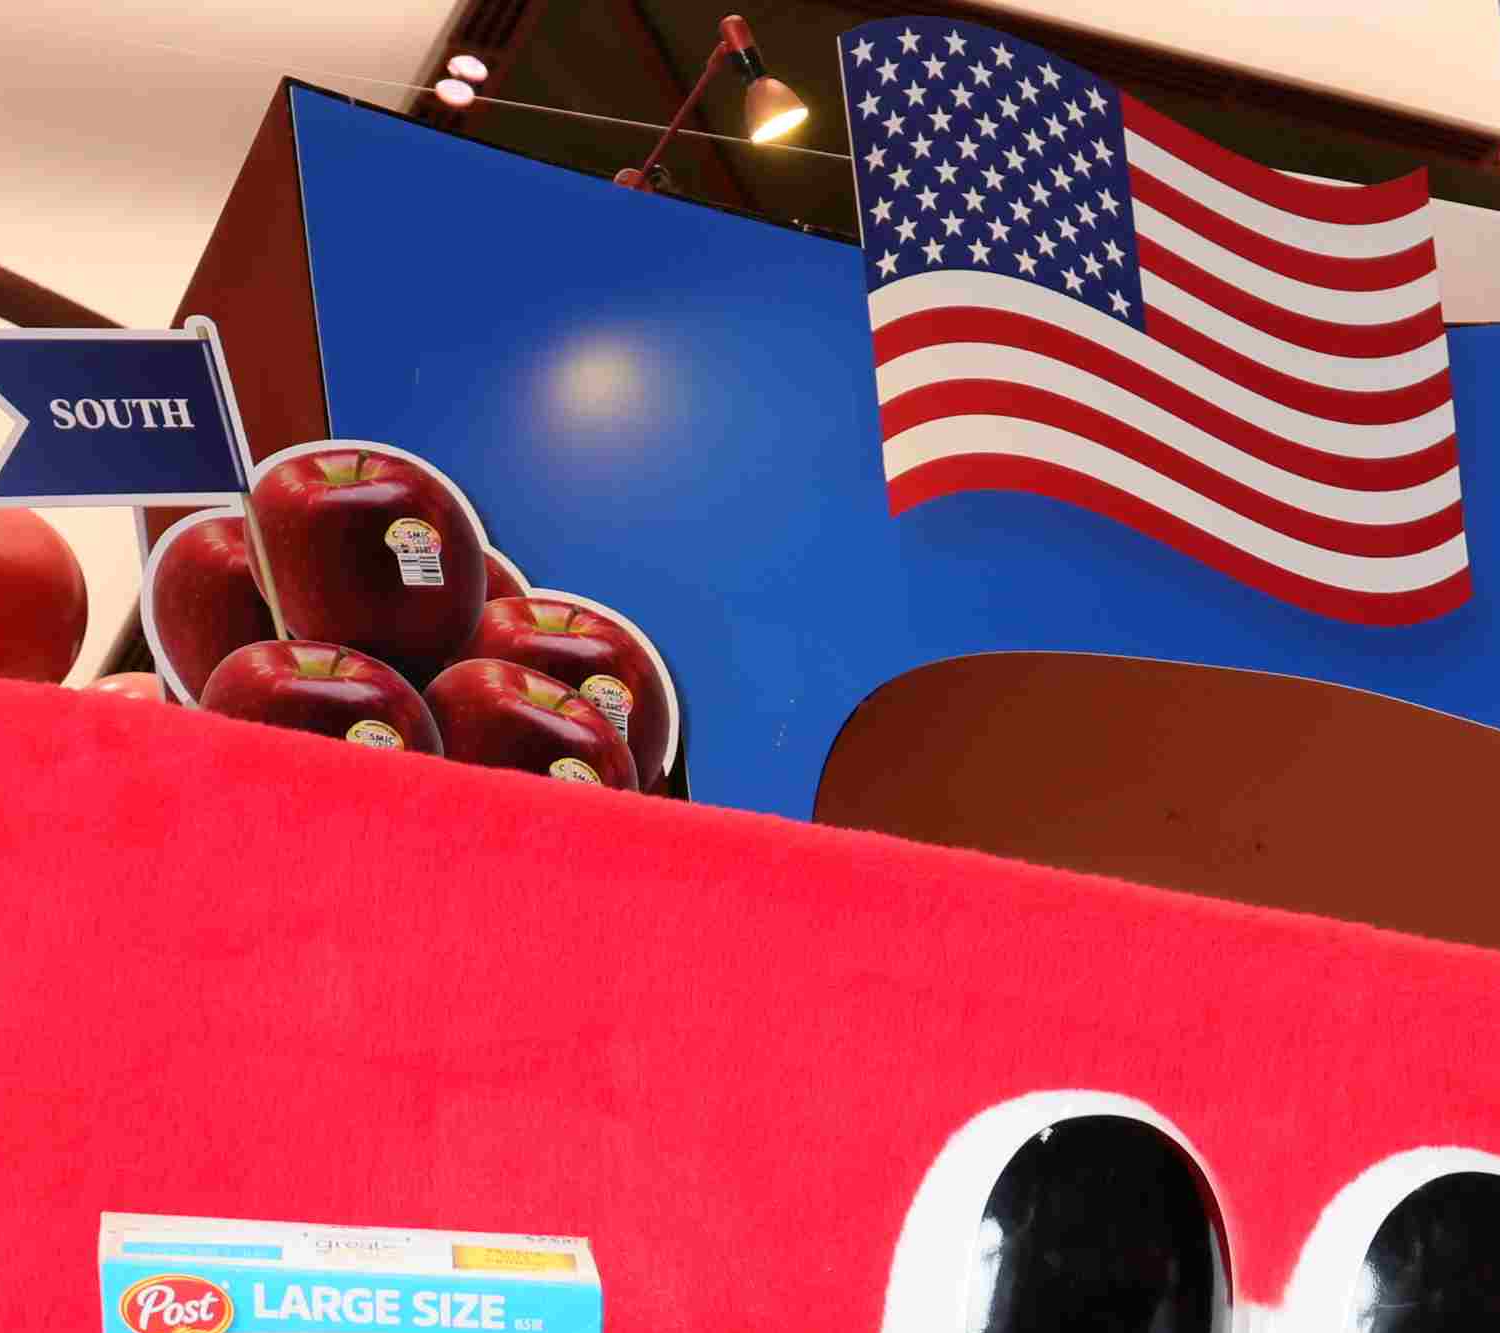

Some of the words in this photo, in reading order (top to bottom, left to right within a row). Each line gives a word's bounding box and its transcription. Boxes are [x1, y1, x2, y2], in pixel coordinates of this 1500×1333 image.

[49, 397, 195, 431] SOUTH
[251, 1280, 402, 1327] LARGE
[412, 1291, 507, 1330] SIZE
